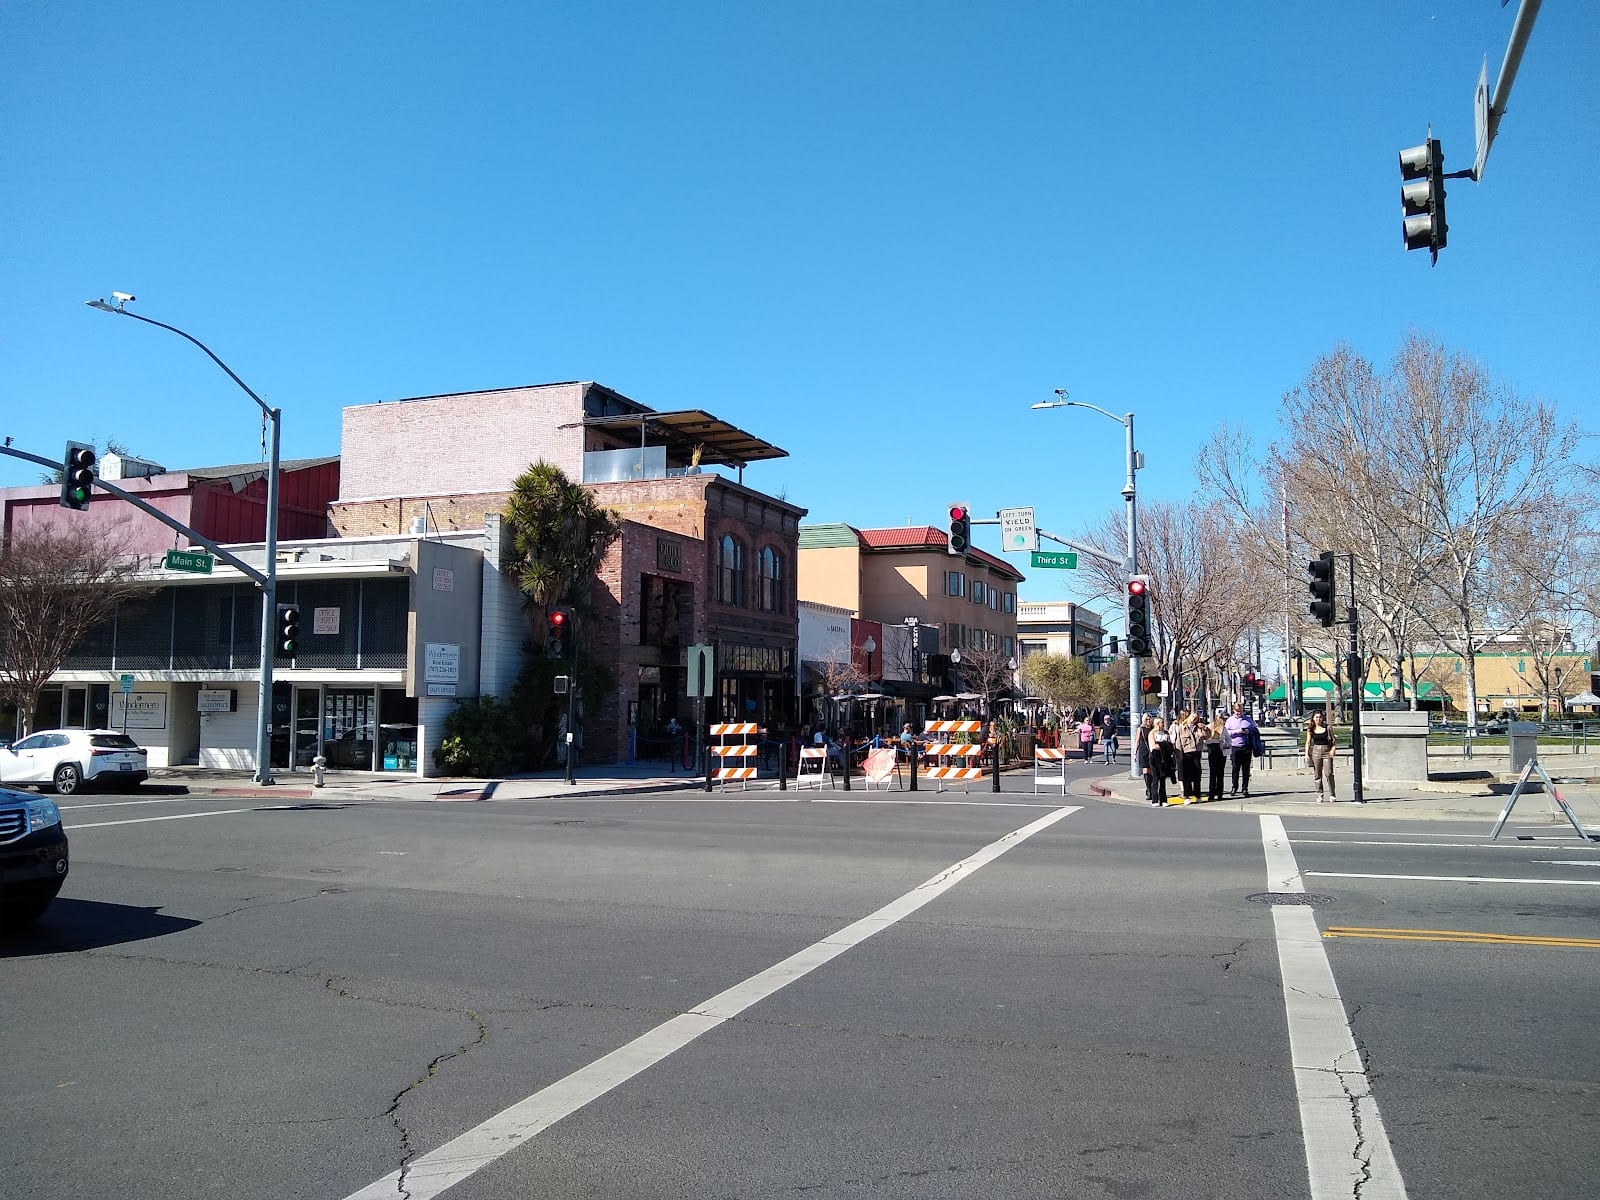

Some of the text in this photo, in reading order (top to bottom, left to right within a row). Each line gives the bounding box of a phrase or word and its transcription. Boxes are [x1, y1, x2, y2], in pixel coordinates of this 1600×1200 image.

[171, 555, 207, 568] Main St.
[1037, 556, 1068, 565] Third St
